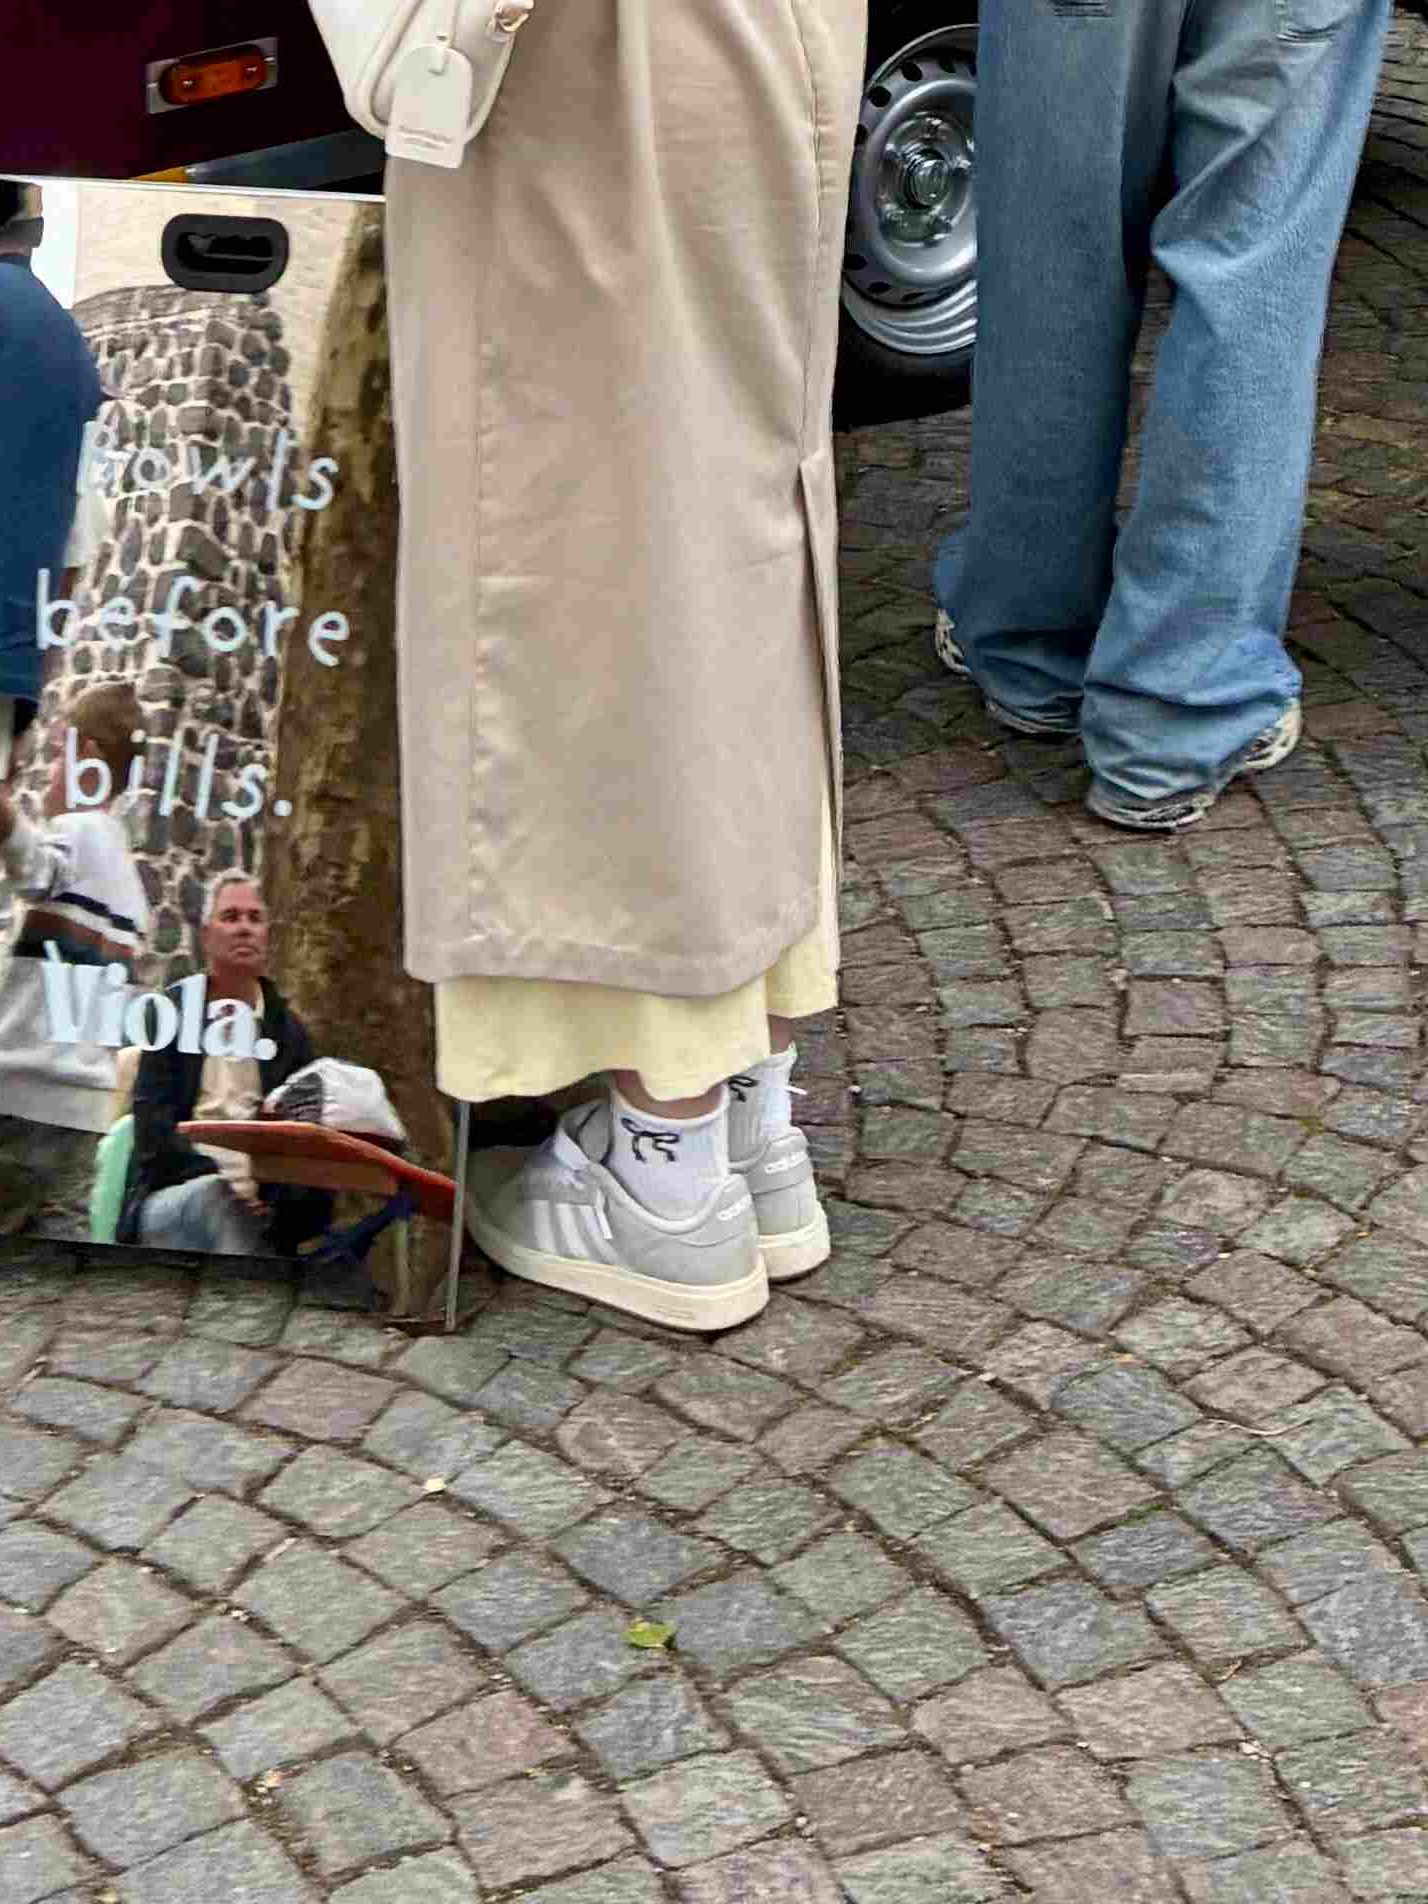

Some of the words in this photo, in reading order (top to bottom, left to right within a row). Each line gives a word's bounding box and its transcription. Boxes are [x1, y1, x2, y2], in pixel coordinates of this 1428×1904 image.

[76, 420, 340, 511] bowls
[36, 567, 350, 667] before
[65, 726, 293, 820] bills.
[42, 939, 279, 1061] Viola.
